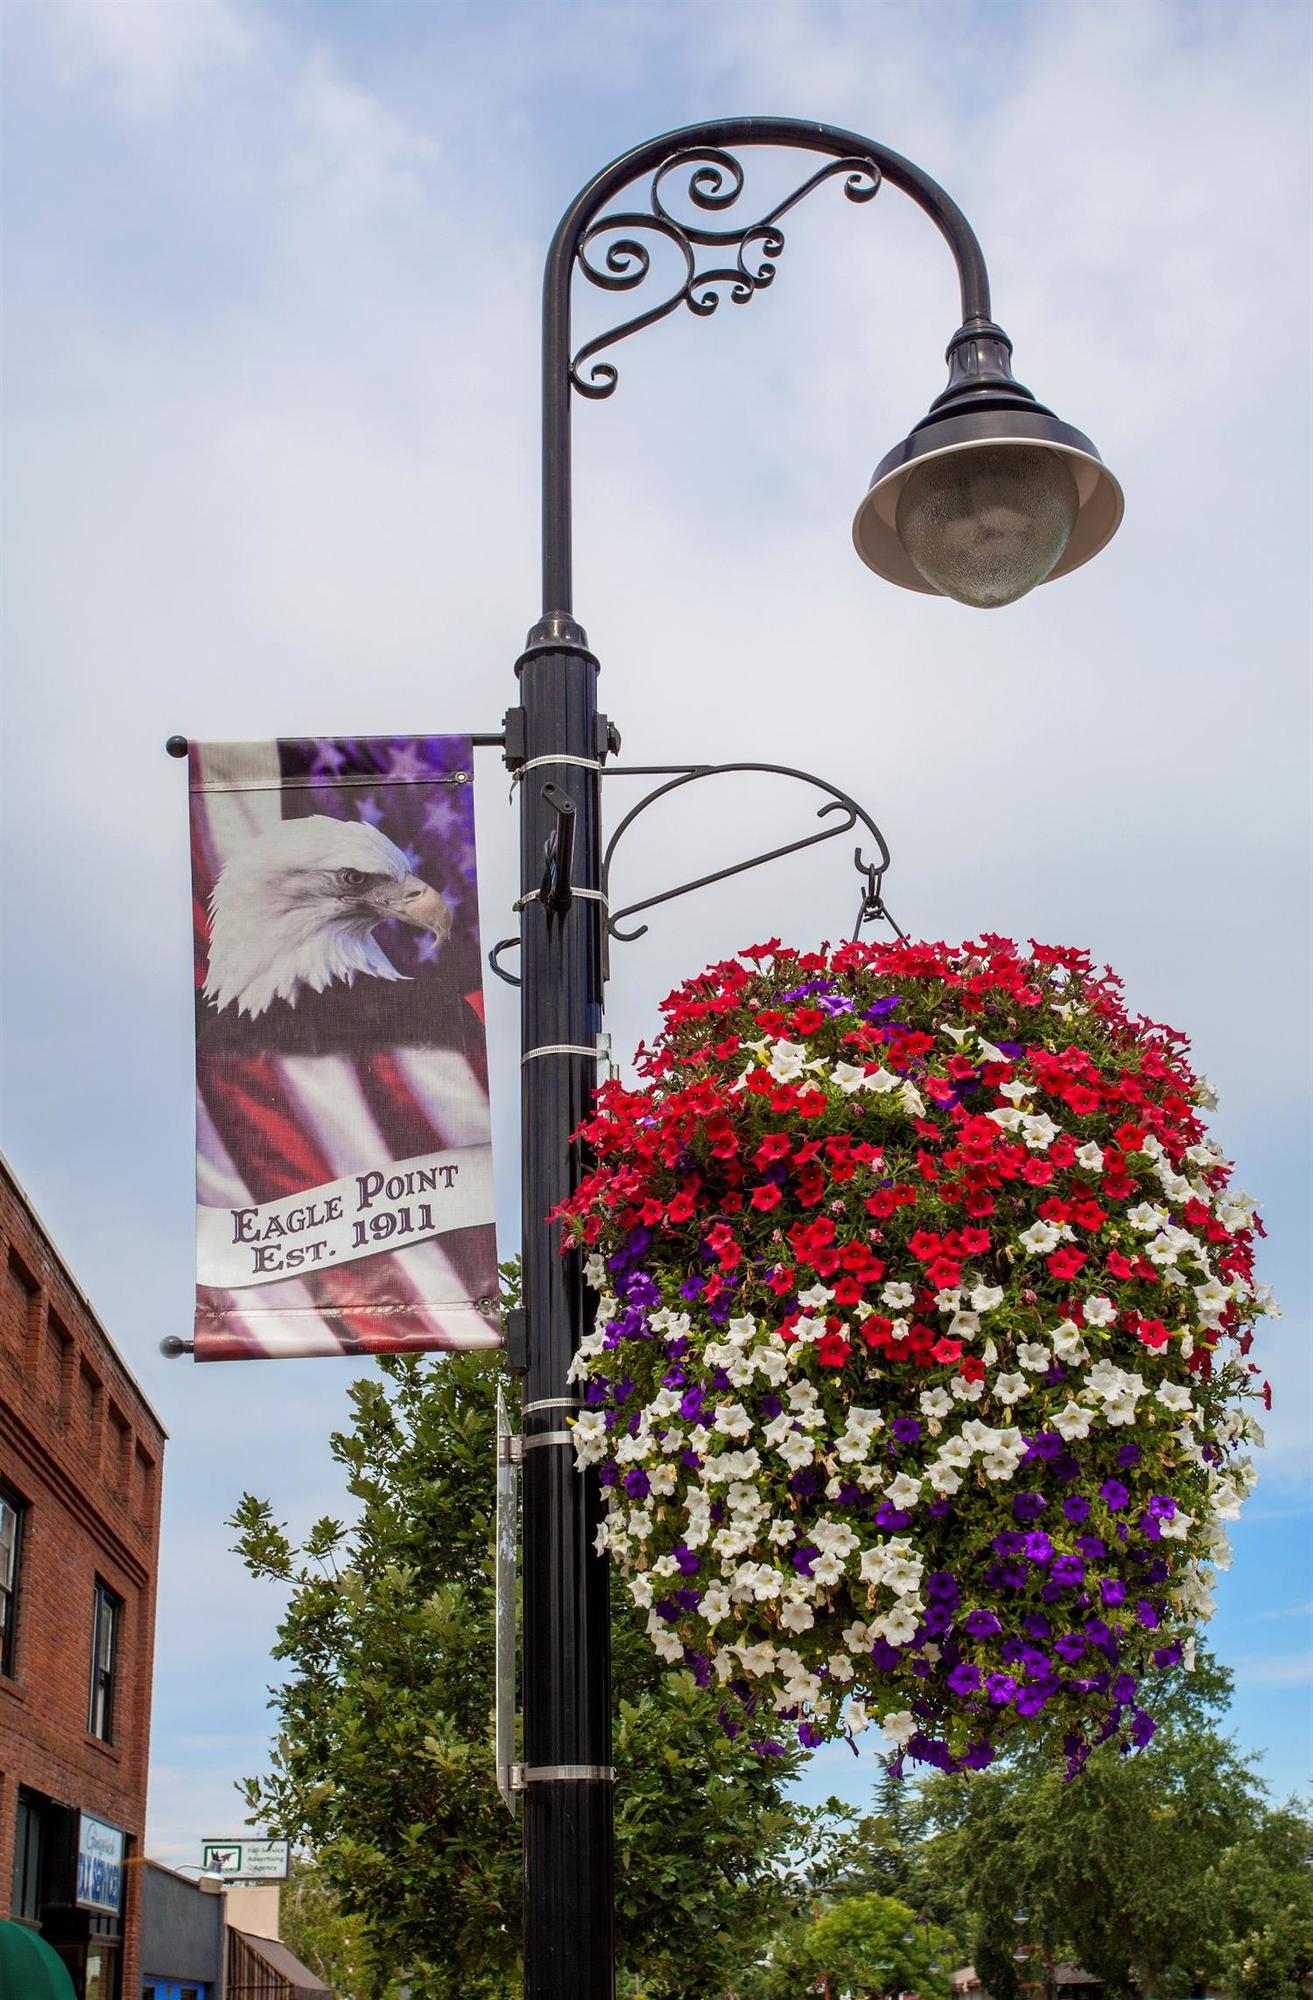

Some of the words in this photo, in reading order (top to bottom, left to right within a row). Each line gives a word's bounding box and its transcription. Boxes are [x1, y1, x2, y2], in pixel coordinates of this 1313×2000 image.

[231, 1196, 343, 1244] EAGLE
[356, 1165, 459, 1212] POINT
[250, 1239, 336, 1274] EST.
[352, 1204, 436, 1248] 1911
